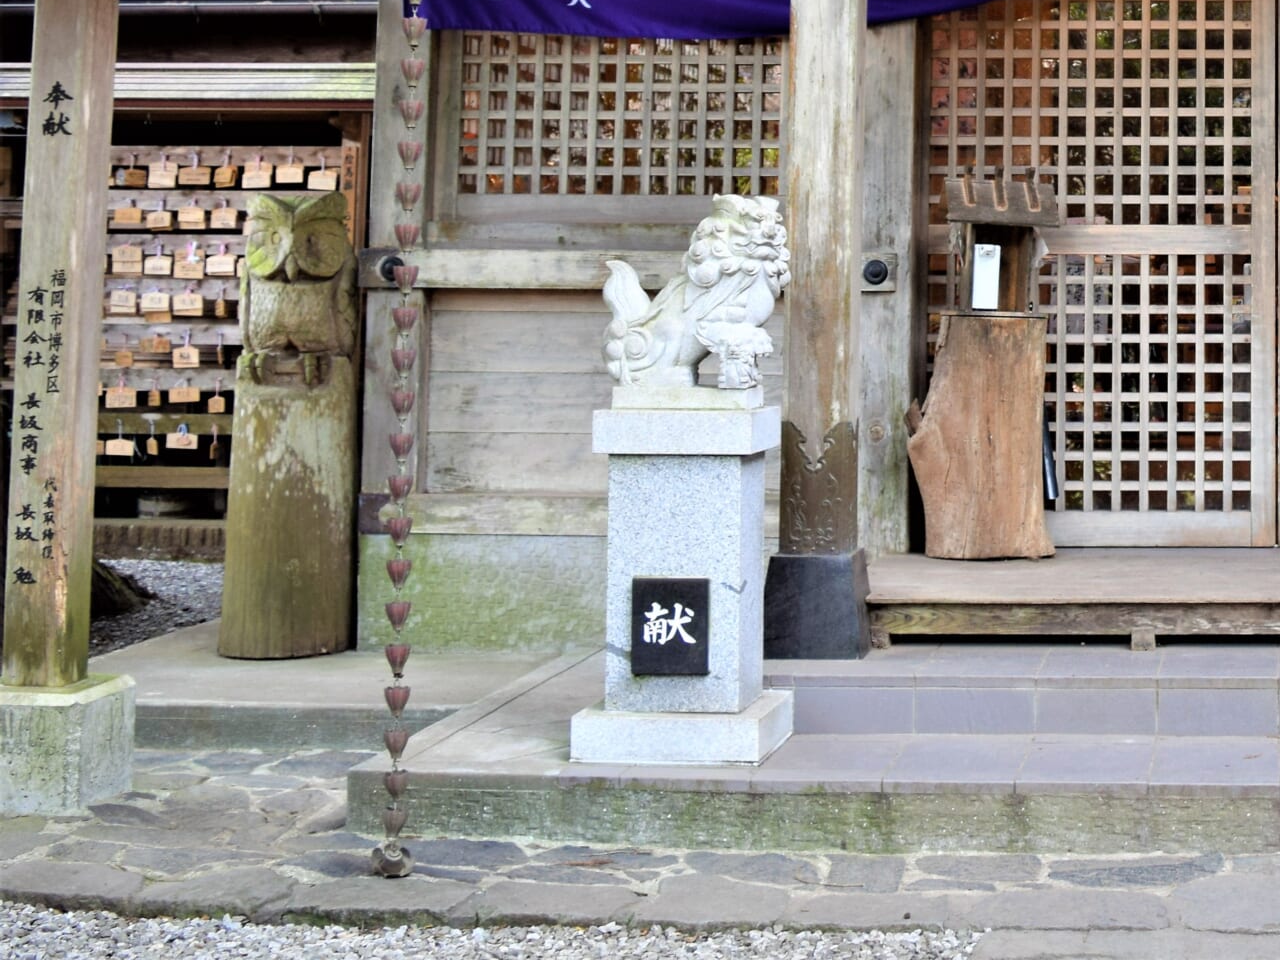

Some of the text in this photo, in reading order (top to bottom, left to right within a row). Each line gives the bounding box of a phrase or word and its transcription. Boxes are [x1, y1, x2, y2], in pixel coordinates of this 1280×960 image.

[42, 80, 74, 136] 奉献
[23, 286, 48, 368] 有限会社
[46, 268, 67, 394] 福岡市博多区
[14, 503, 39, 543] 長坂
[42, 477, 58, 560] 代表取締役
[643, 601, 697, 646] 献
